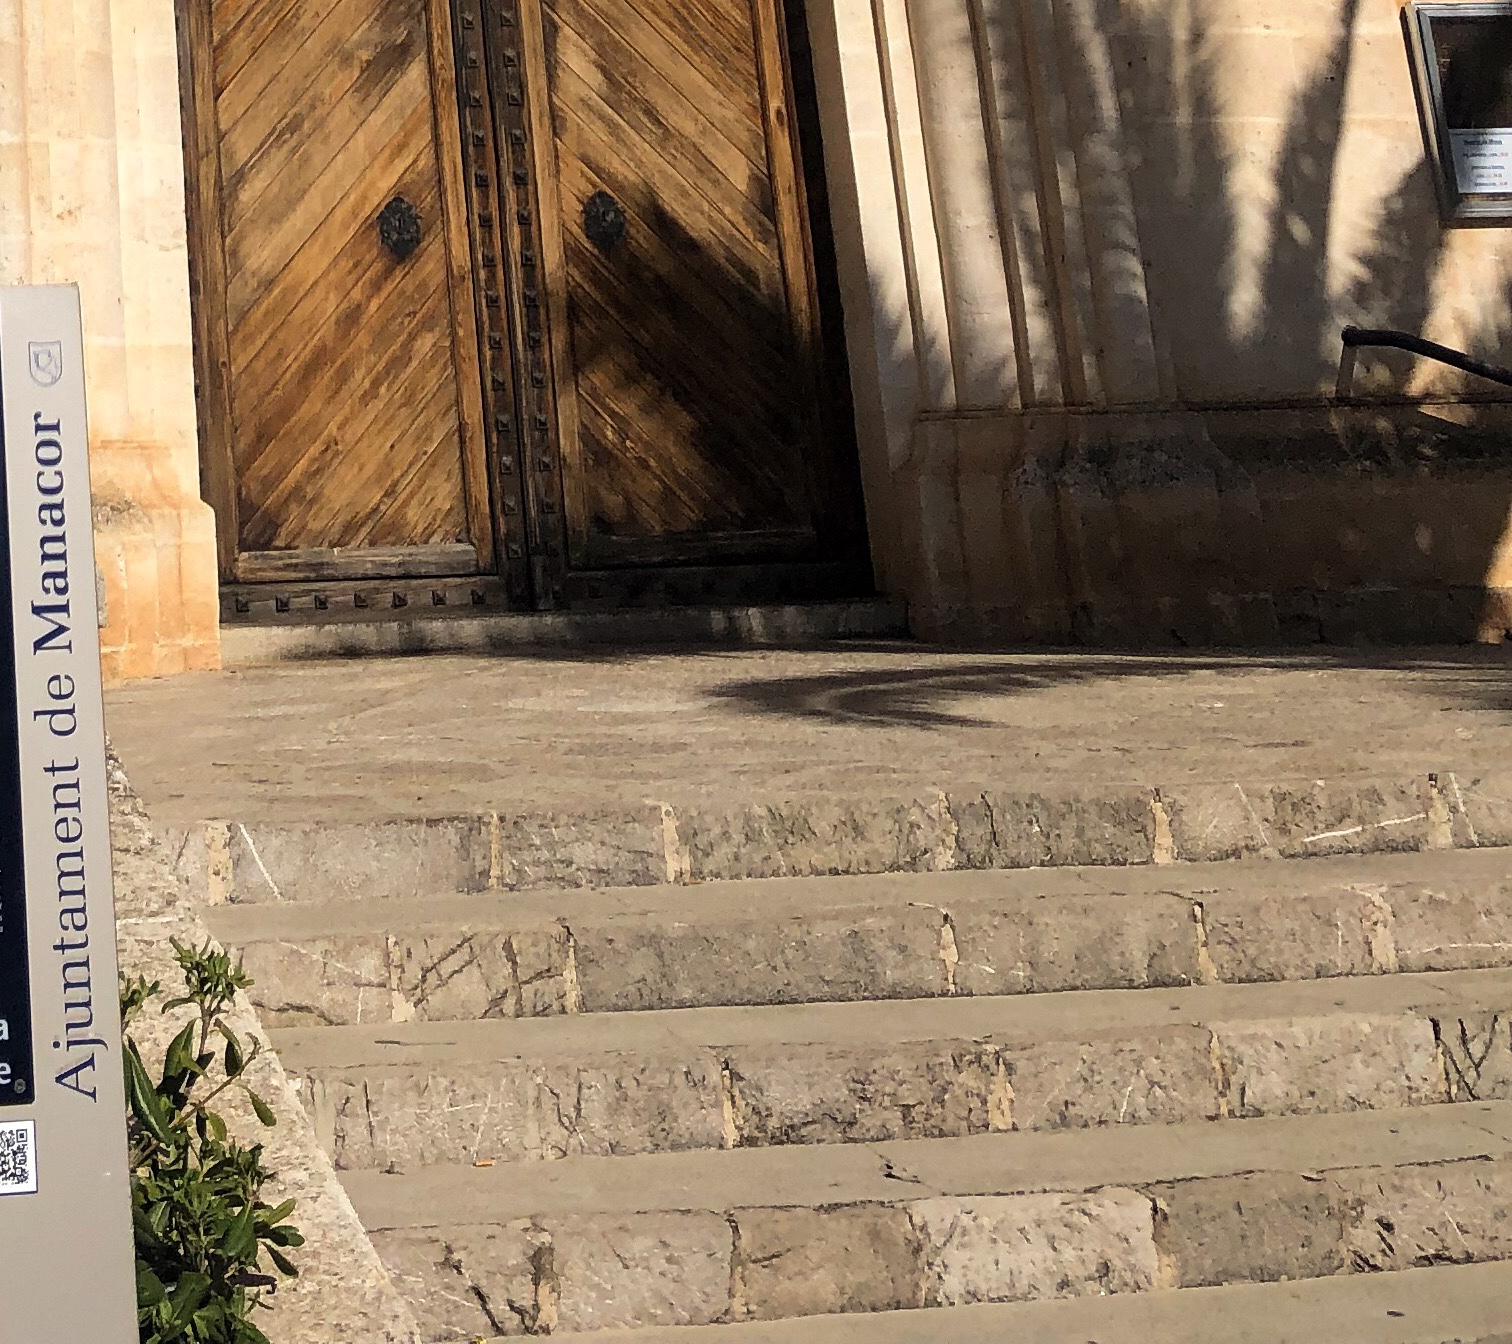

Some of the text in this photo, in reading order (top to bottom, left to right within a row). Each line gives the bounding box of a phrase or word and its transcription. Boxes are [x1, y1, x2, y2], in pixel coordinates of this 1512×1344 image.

[30, 411, 101, 1104] Ajuntament de Manacor
